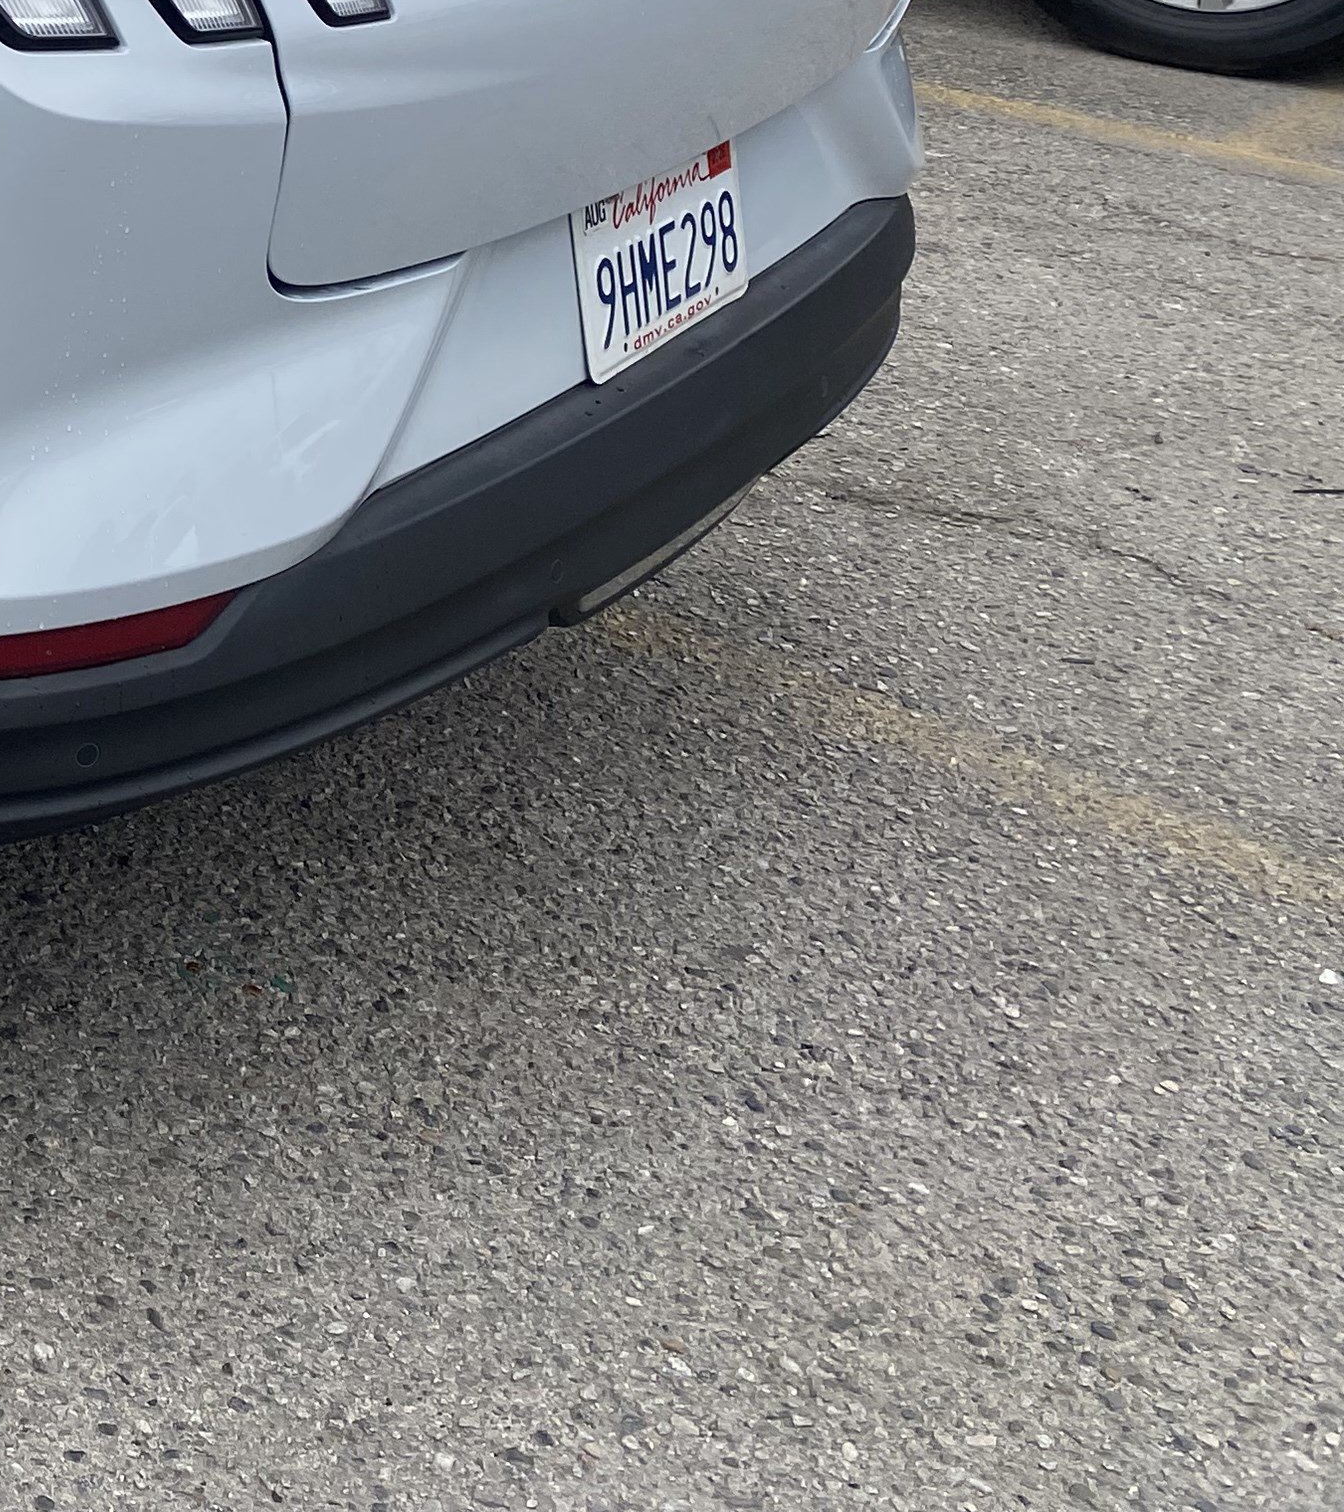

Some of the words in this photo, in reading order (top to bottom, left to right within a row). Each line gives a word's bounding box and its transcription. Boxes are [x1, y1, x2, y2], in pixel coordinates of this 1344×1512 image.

[584, 199, 607, 230] AUG
[612, 162, 711, 229] California
[596, 190, 738, 349] 9HME298
[634, 296, 712, 350] dmv.ca.gov
